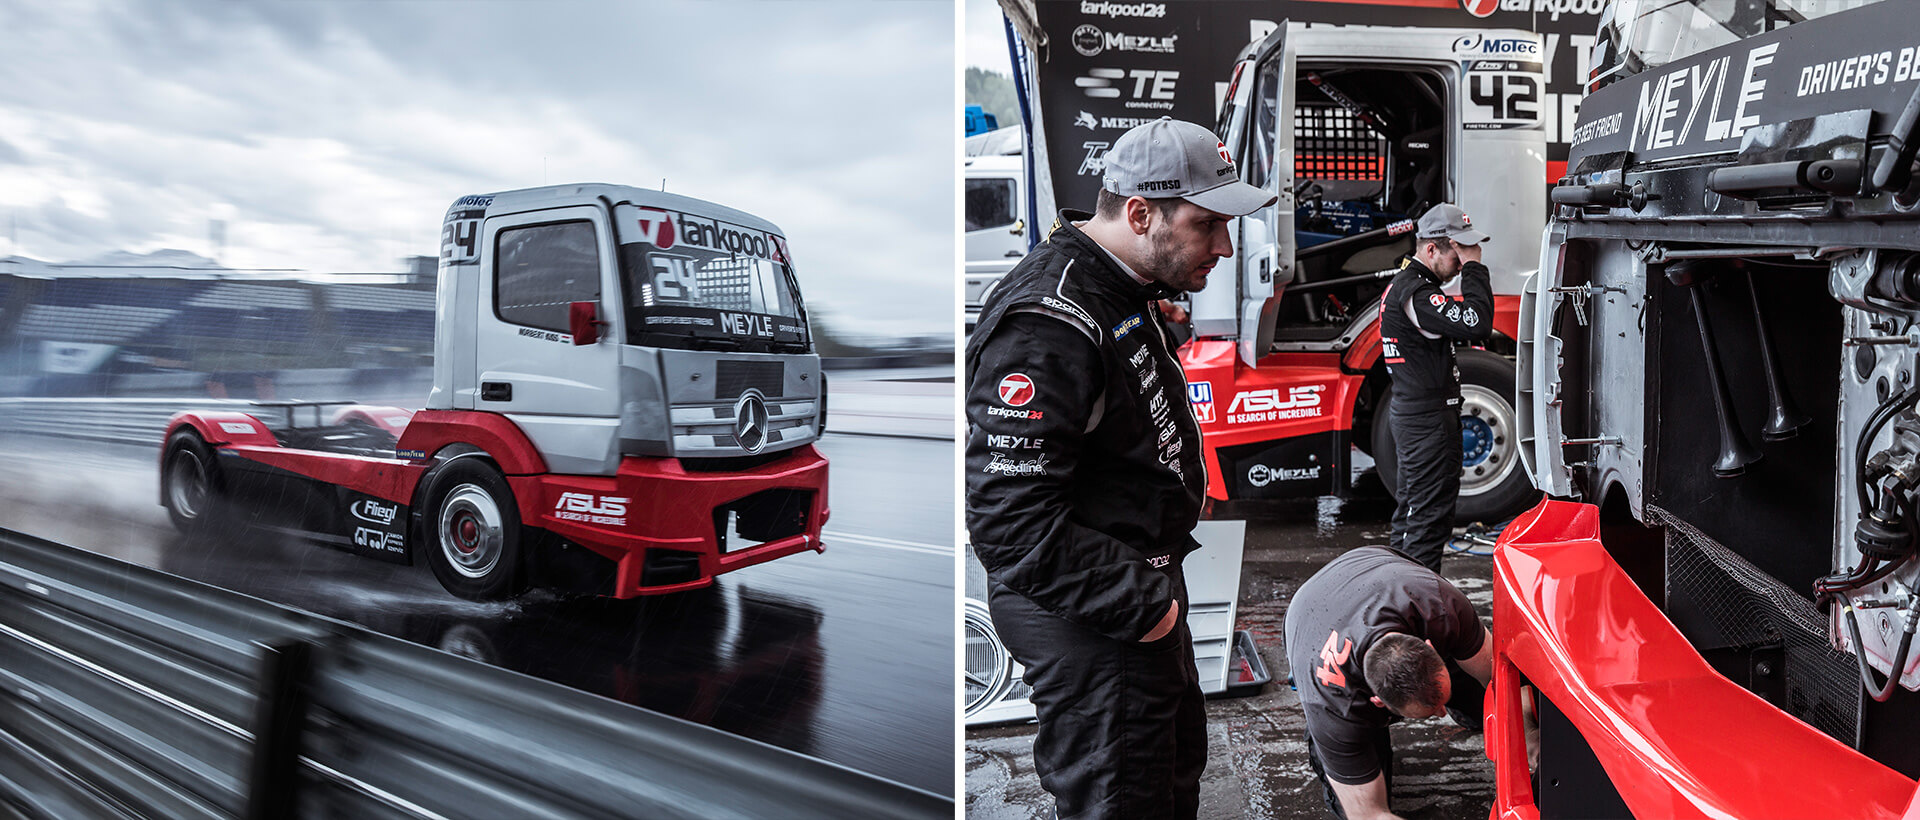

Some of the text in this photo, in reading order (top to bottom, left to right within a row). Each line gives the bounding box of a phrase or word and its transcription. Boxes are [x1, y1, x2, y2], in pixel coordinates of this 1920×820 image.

[1080, 0, 1166, 18] tankpool24
[1129, 70, 1179, 99] TE
[1797, 51, 1892, 97] DRIVER'S
[1125, 101, 1174, 110] connectivity
[1470, 75, 1538, 120] 42
[1629, 42, 1780, 152] MEYLE
[441, 221, 477, 257] 24
[652, 257, 700, 299] 24
[720, 312, 774, 337] MEYLE
[1227, 385, 1320, 413] ASUS
[987, 405, 1044, 420] tankpool24
[1228, 407, 1322, 424] IN SEARCH OF INCREDIBLE
[987, 434, 1044, 449] MEYLE
[364, 500, 397, 522] Fliegl
[555, 492, 631, 516] ASUS
[1316, 630, 1352, 688] 24
